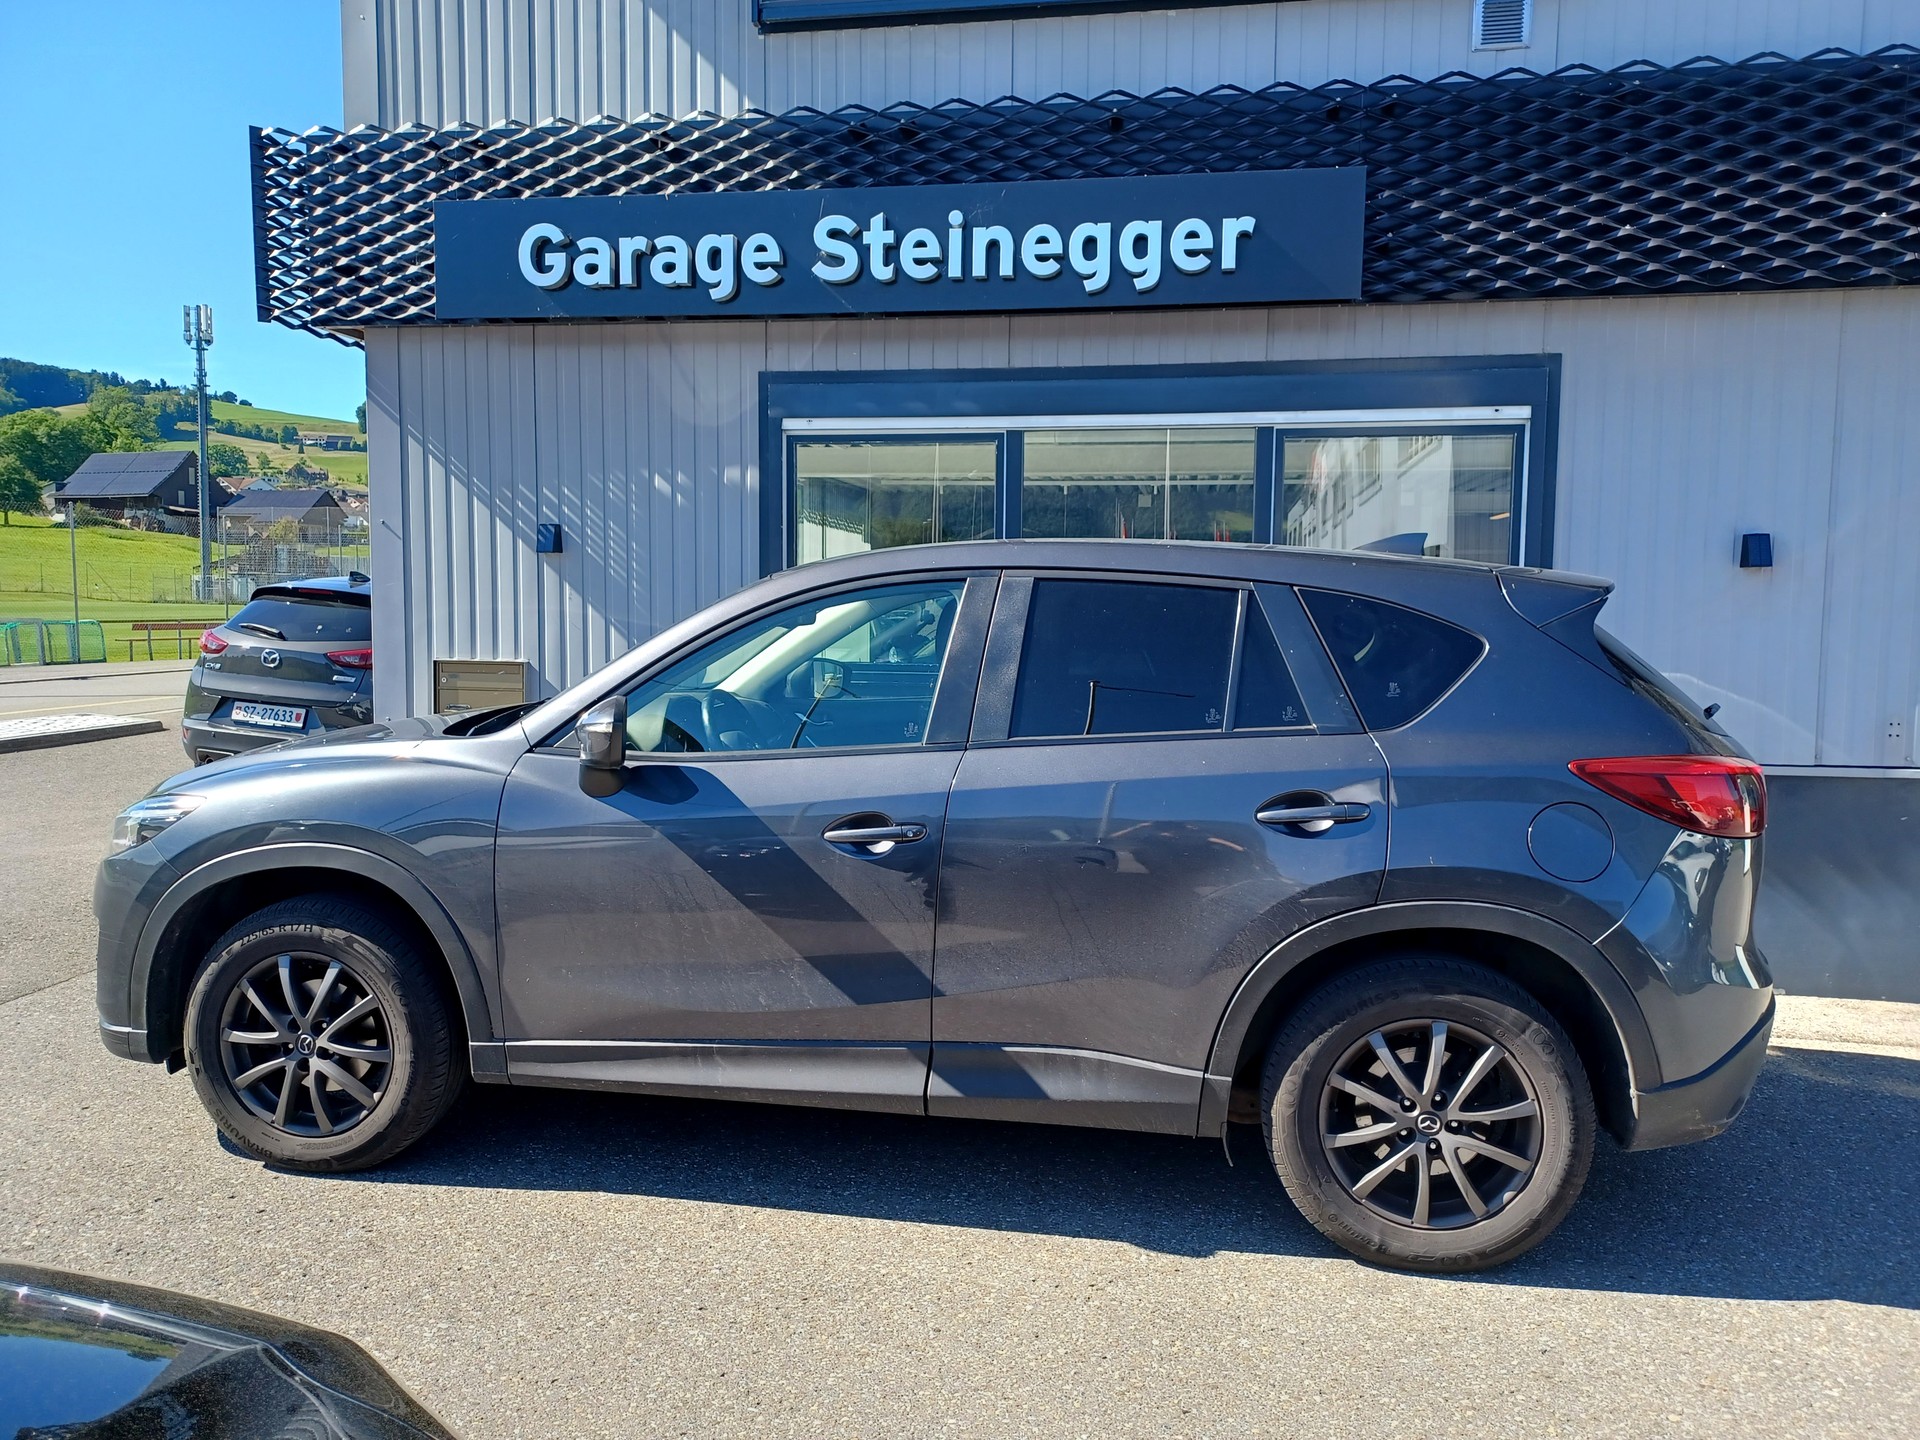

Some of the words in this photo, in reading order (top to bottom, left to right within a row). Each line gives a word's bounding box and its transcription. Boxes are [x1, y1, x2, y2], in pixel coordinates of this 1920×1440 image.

[518, 222, 784, 302] Garage
[811, 209, 1257, 294] Steinegger
[213, 1108, 274, 1160] BRAVURIS
